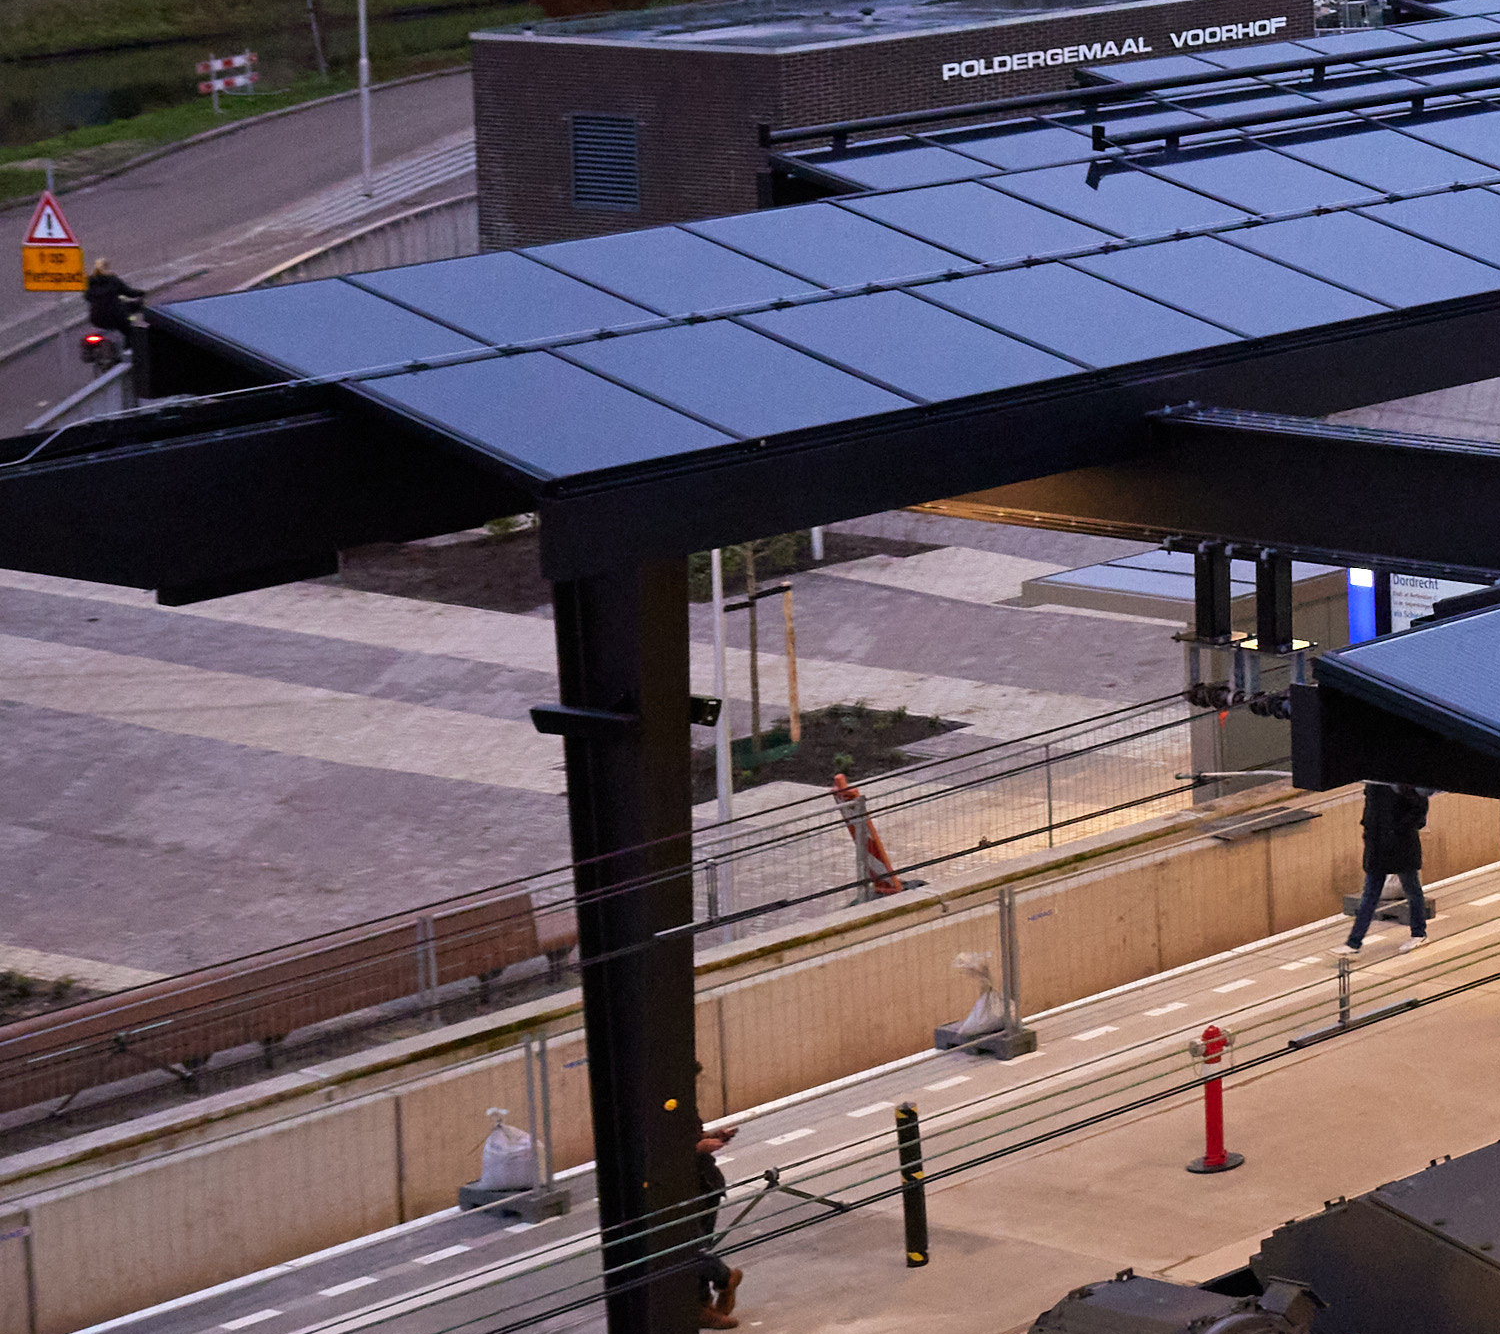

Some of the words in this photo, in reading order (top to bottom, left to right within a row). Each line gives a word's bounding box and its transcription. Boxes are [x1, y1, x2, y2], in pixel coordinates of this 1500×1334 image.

[942, 37, 1152, 80] POLDERGEMAAL
[1170, 16, 1287, 48] VOORHOF
[1393, 575, 1439, 590] Dordrecht
